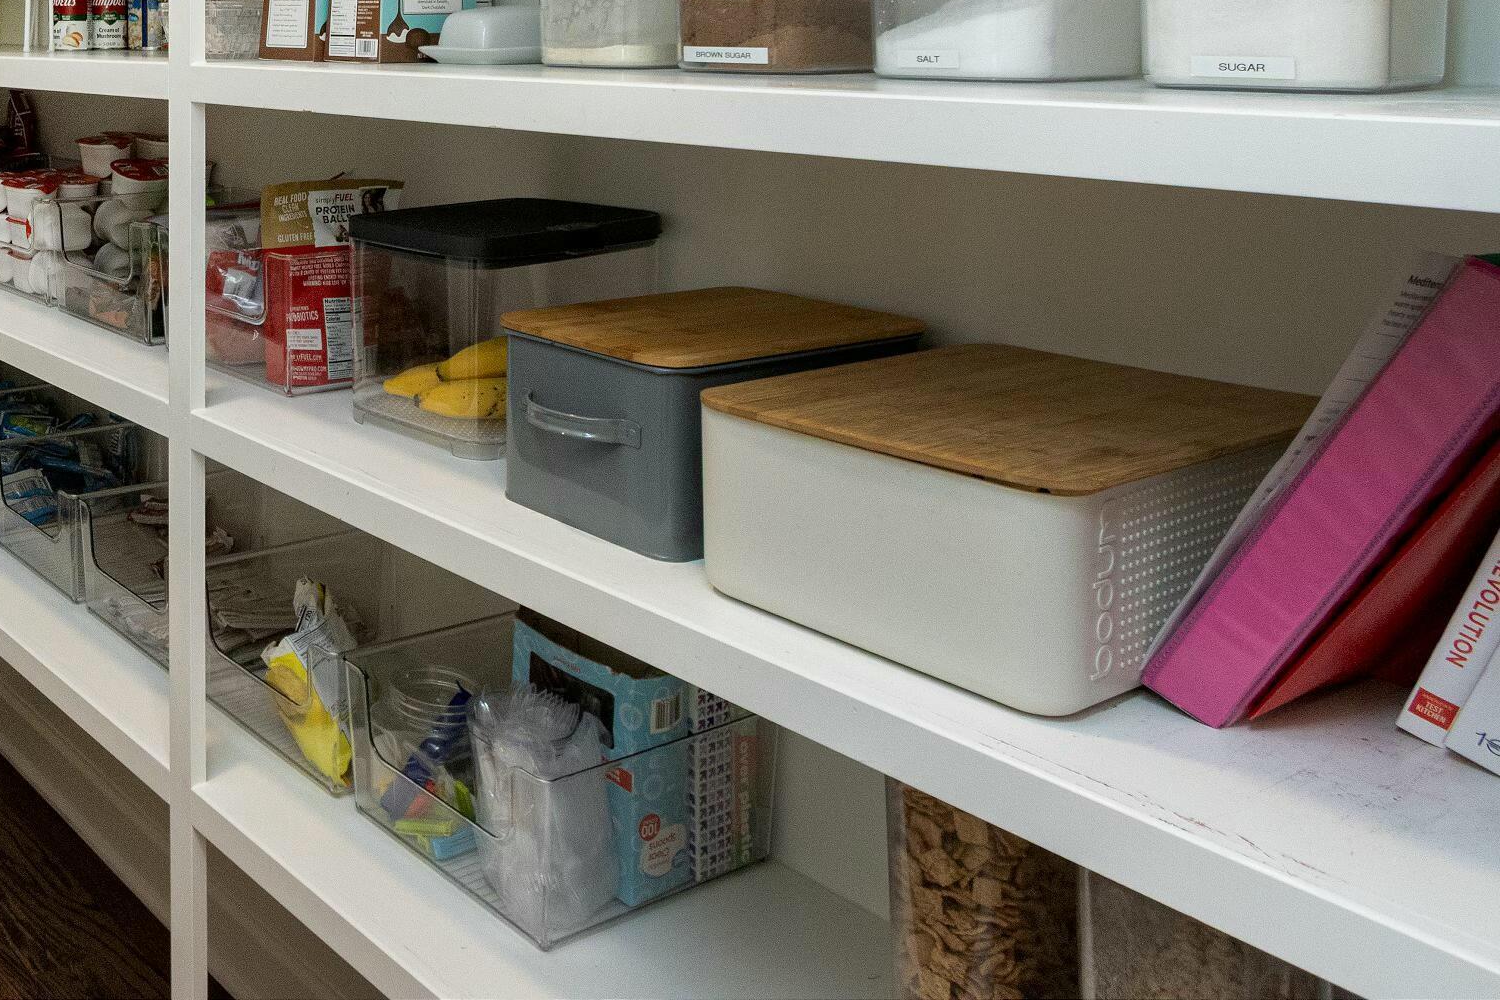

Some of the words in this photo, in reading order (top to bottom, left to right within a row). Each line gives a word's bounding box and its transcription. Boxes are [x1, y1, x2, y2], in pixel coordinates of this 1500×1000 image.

[695, 51, 724, 60] BROWN
[724, 51, 751, 60] SUGAR
[916, 55, 940, 63] SALT
[1218, 62, 1266, 73] SUGAR
[315, 203, 356, 216] PROTEIN
[1445, 560, 1500, 668] EVOLUTION
[1414, 703, 1448, 725] KITCHEN
[1424, 700, 1445, 715] TEST
